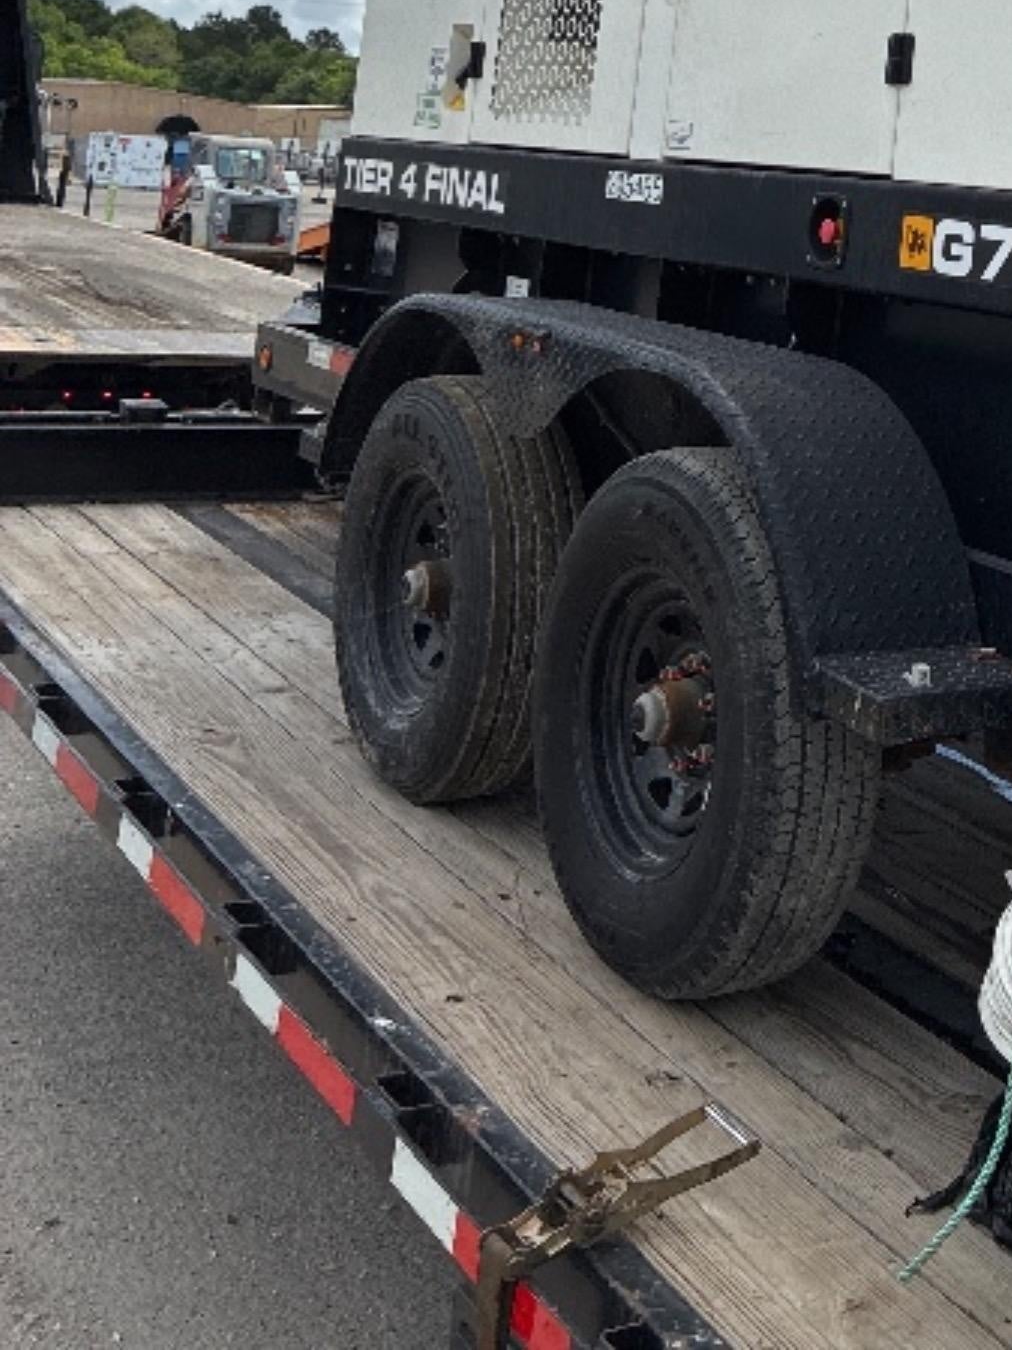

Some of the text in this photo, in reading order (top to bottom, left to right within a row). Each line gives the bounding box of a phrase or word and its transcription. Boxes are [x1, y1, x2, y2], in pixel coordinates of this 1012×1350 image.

[344, 156, 504, 214] TIER 4 FINAL
